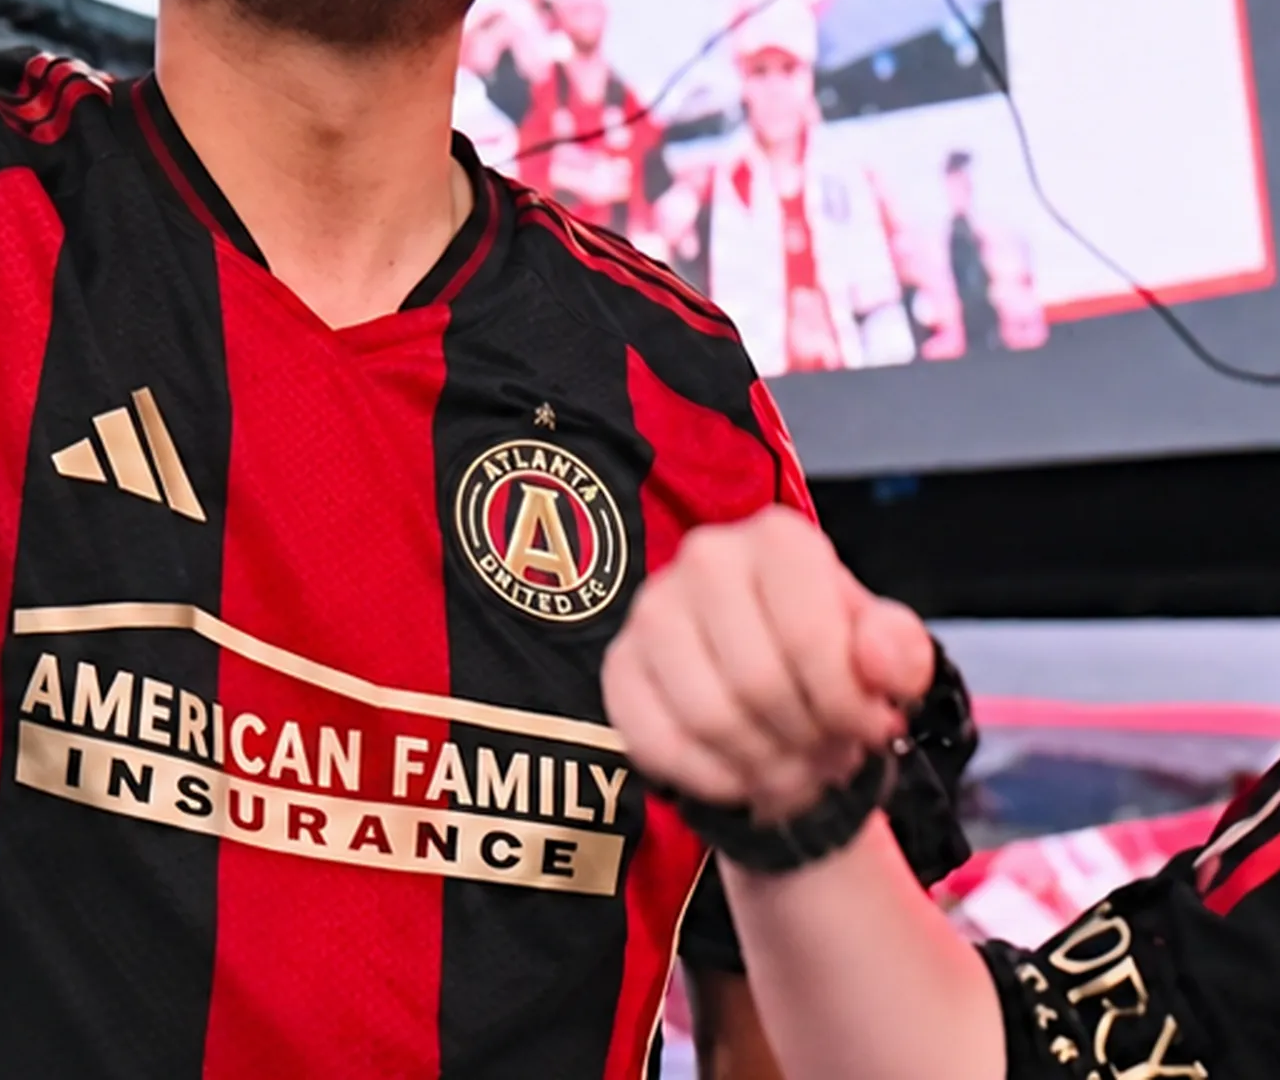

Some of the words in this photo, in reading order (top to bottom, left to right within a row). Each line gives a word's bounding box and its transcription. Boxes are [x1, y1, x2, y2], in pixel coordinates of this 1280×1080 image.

[482, 448, 599, 503] ATLANTA
[480, 554, 571, 614] UNITED
[578, 578, 607, 608] FC
[21, 652, 364, 793] AMERICAN
[393, 735, 628, 825] FAMILY
[64, 746, 577, 879] INSURANCE
[1048, 900, 1208, 1080] ORY
